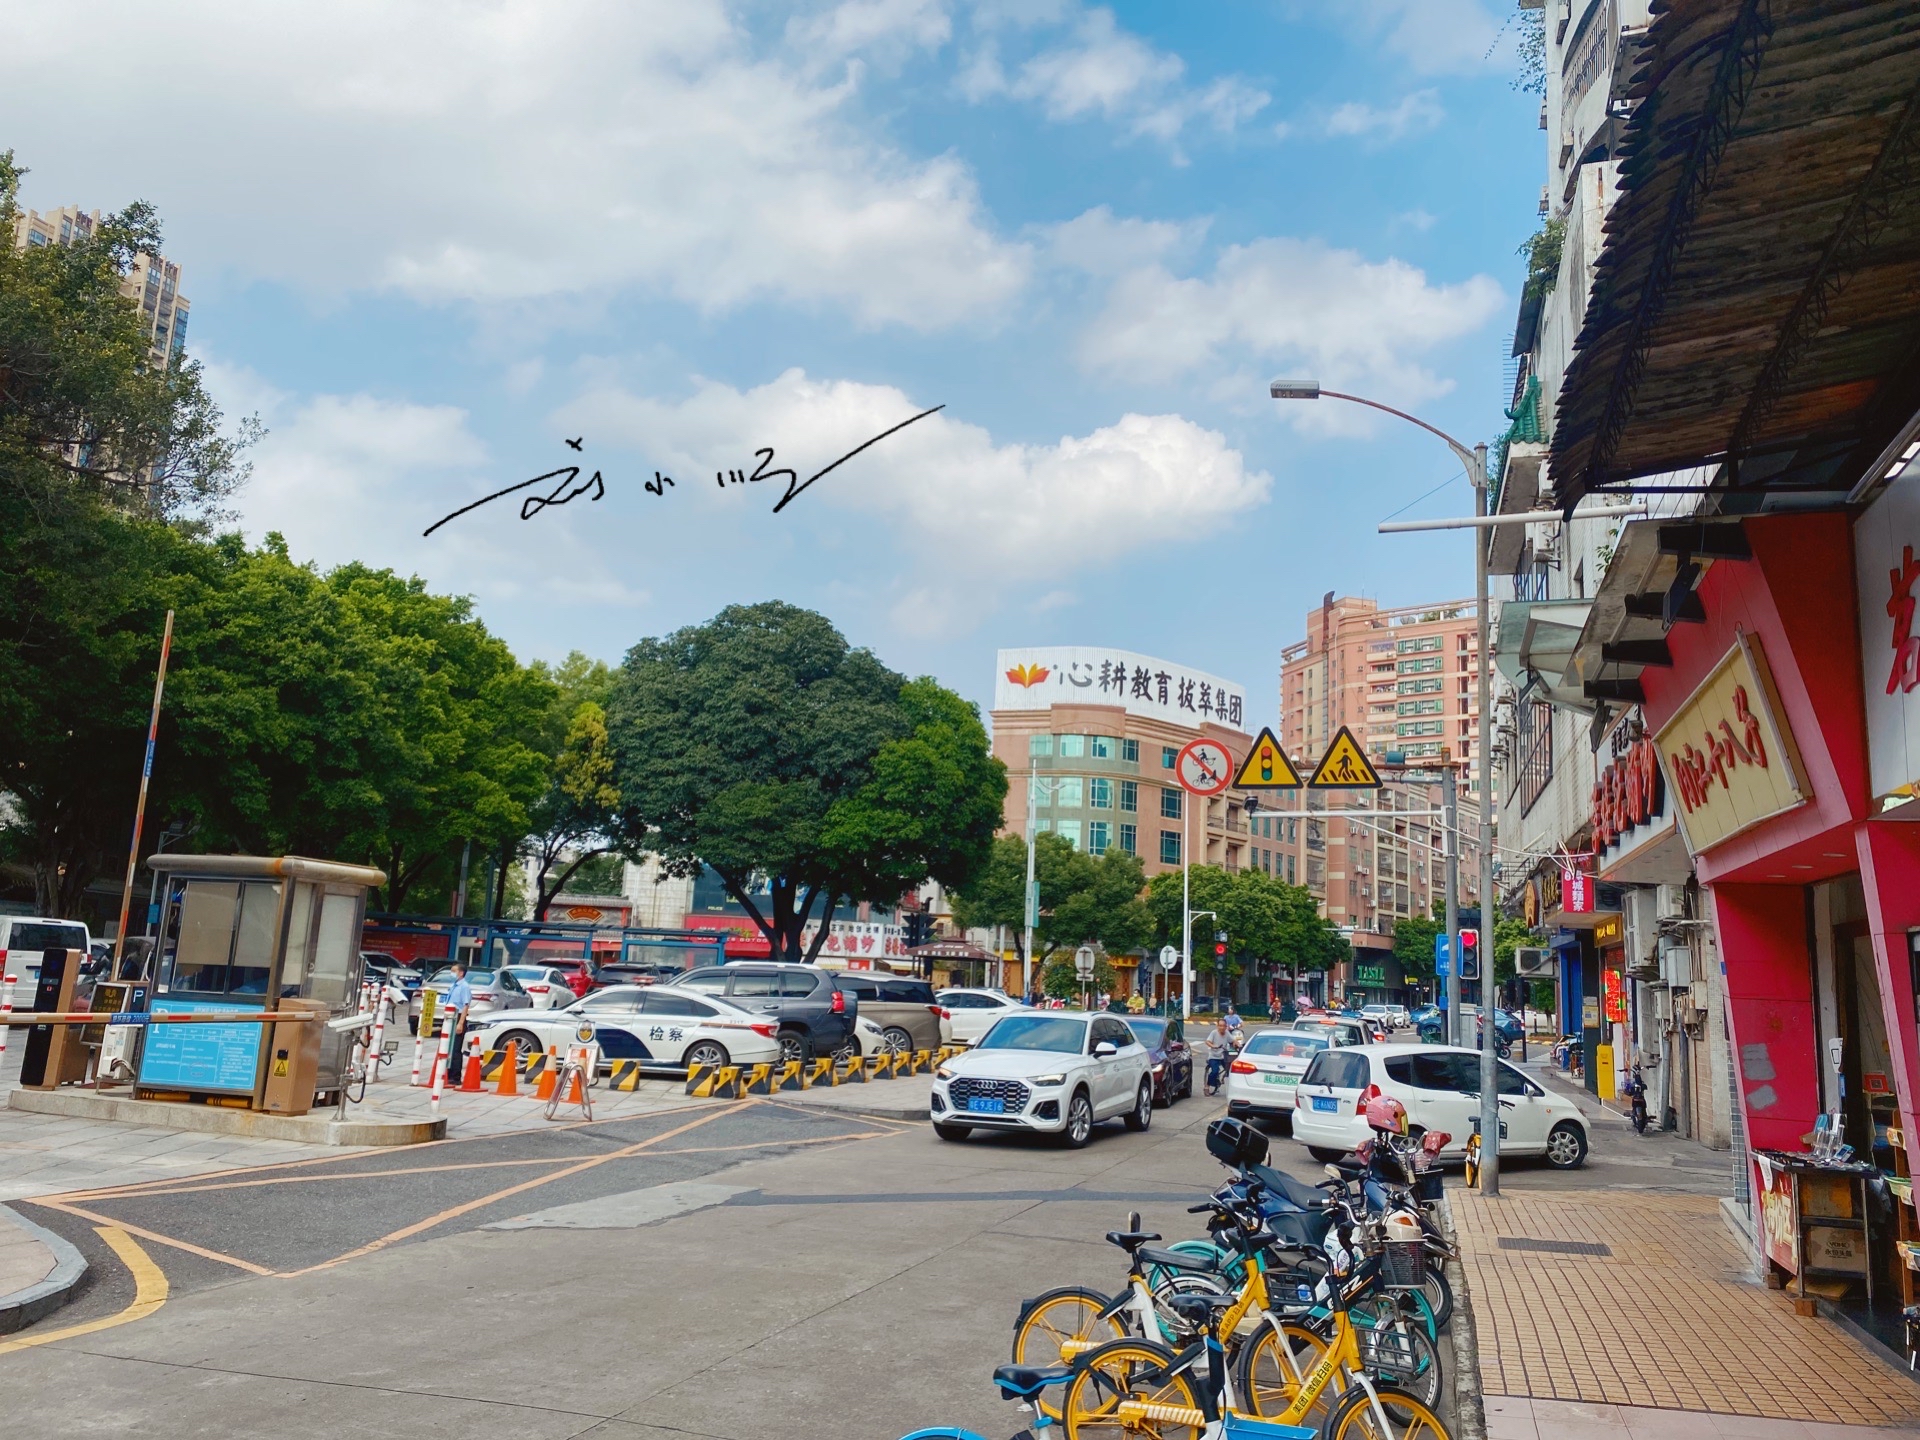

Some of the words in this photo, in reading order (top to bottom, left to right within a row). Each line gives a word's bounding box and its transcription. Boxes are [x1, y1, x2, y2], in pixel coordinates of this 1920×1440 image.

[1177, 676, 1243, 727] 拔萃集团
[649, 1026, 684, 1042] 检察
[1292, 1395, 1309, 1413] 美团
[1305, 1360, 1333, 1396] 微信扫码
